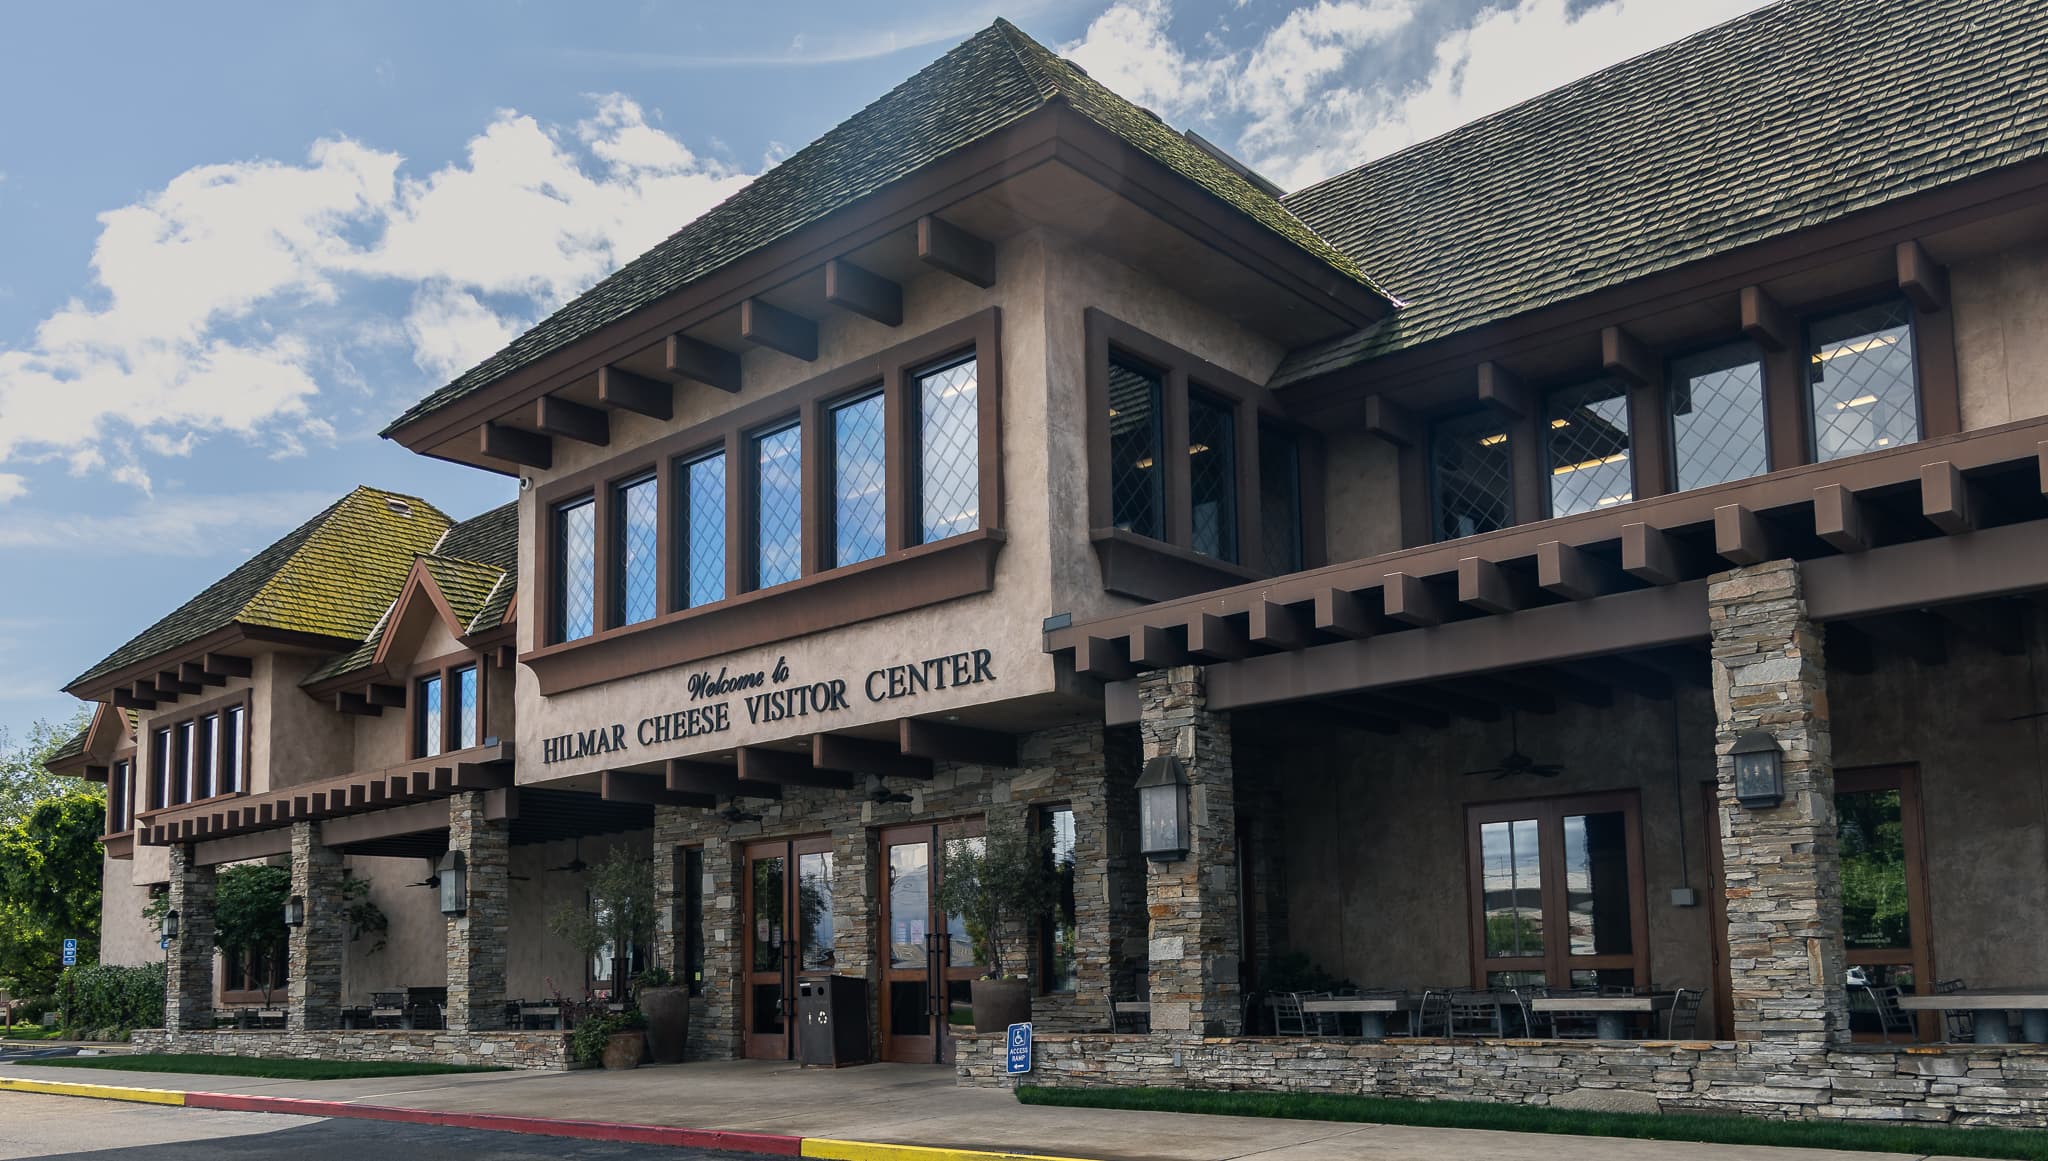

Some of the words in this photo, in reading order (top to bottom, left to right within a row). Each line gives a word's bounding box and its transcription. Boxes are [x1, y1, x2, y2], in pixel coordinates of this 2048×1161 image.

[687, 667, 764, 702] Welcome
[771, 655, 790, 684] to
[543, 724, 628, 764] HILMAR
[637, 702, 730, 746] CHEESE
[744, 678, 850, 725] VISITOR
[864, 648, 996, 702] CENTER
[1009, 1047, 1028, 1055] ACCESS
[1011, 1054, 1026, 1062] RAMP
